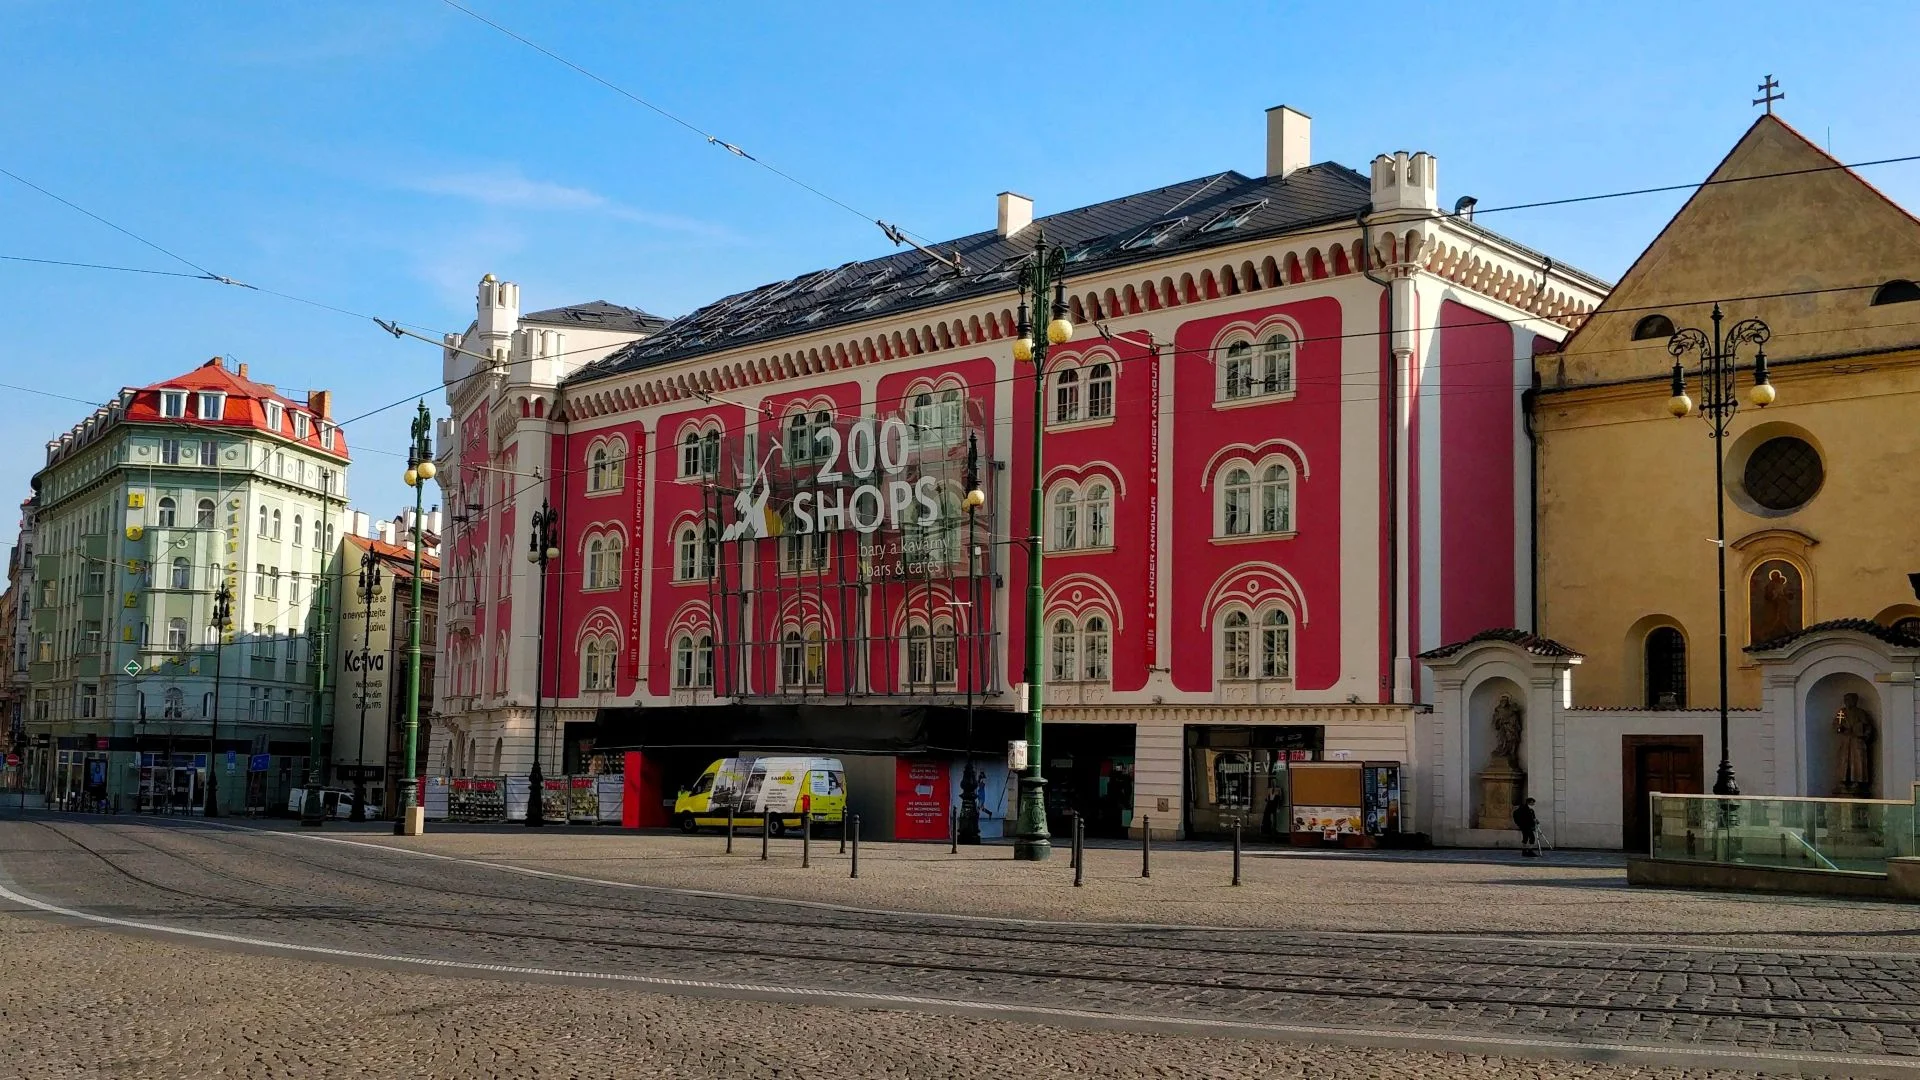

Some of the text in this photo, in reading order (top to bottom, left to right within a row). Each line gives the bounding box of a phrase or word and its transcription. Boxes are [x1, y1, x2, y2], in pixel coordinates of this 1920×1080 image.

[815, 417, 909, 483] 200
[230, 498, 241, 553] CITY
[793, 475, 938, 535] SHOPS
[124, 493, 145, 641] HOTEL
[860, 541, 886, 560] bary
[890, 543, 897, 554] a
[866, 563, 891, 577] bars
[895, 560, 904, 575] &
